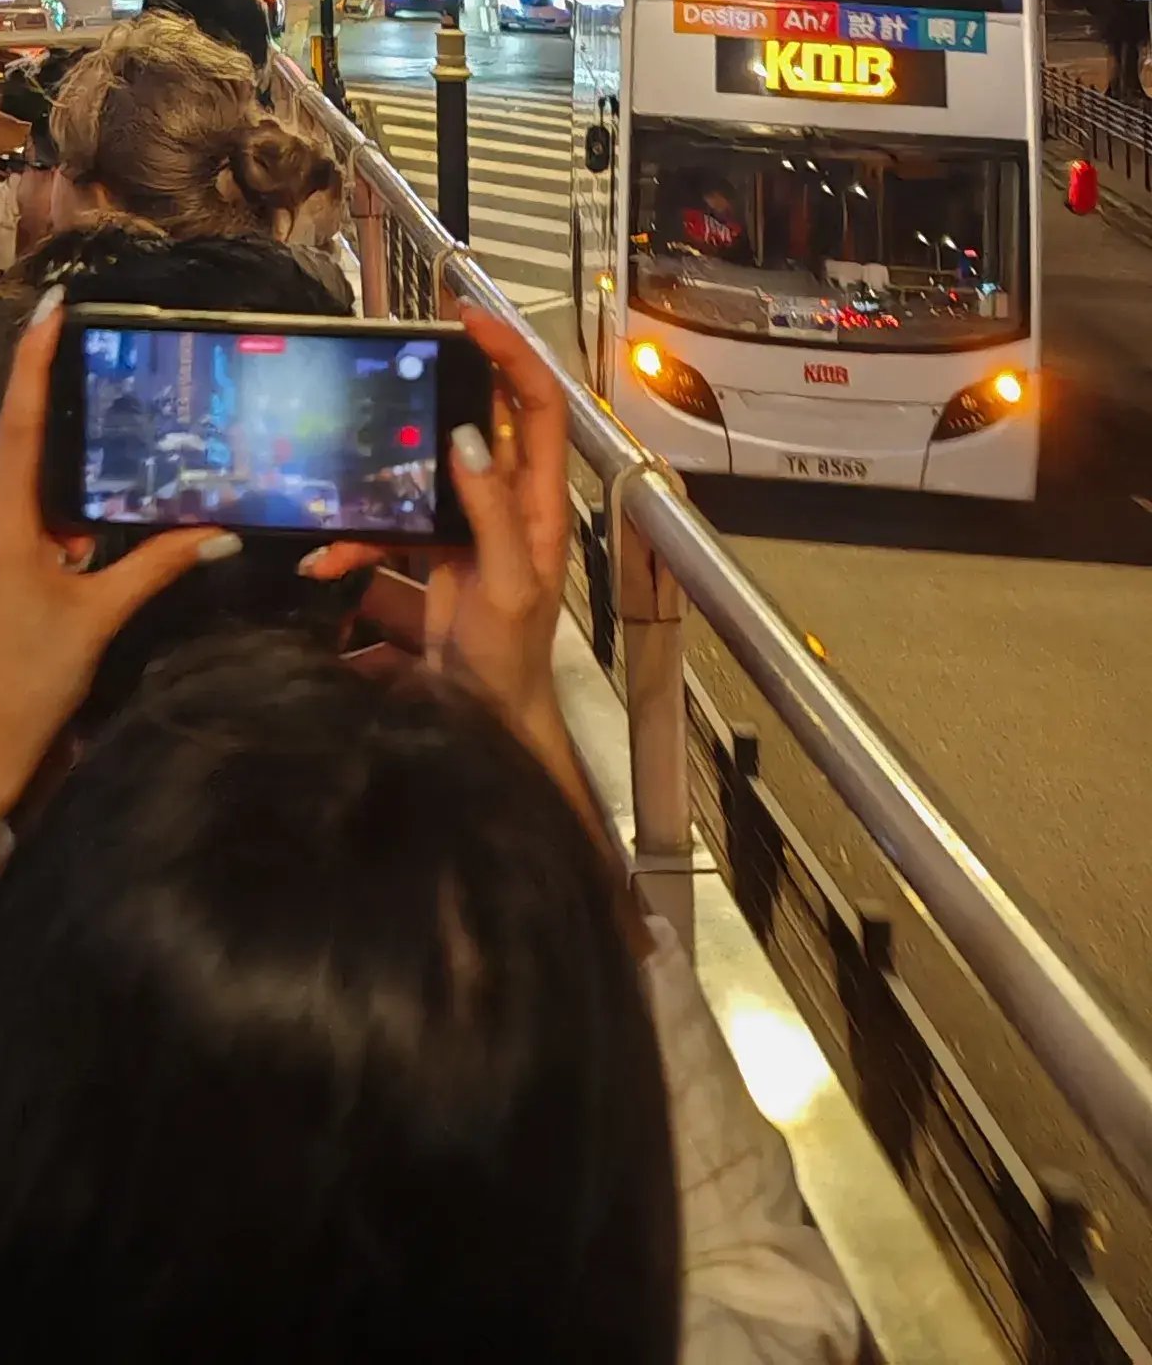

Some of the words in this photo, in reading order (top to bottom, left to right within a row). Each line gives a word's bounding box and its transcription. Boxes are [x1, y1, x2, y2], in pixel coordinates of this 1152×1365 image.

[682, 2, 768, 33] Design
[783, 8, 832, 33] Ah!
[847, 10, 910, 44] 設計
[764, 39, 897, 97] KMB
